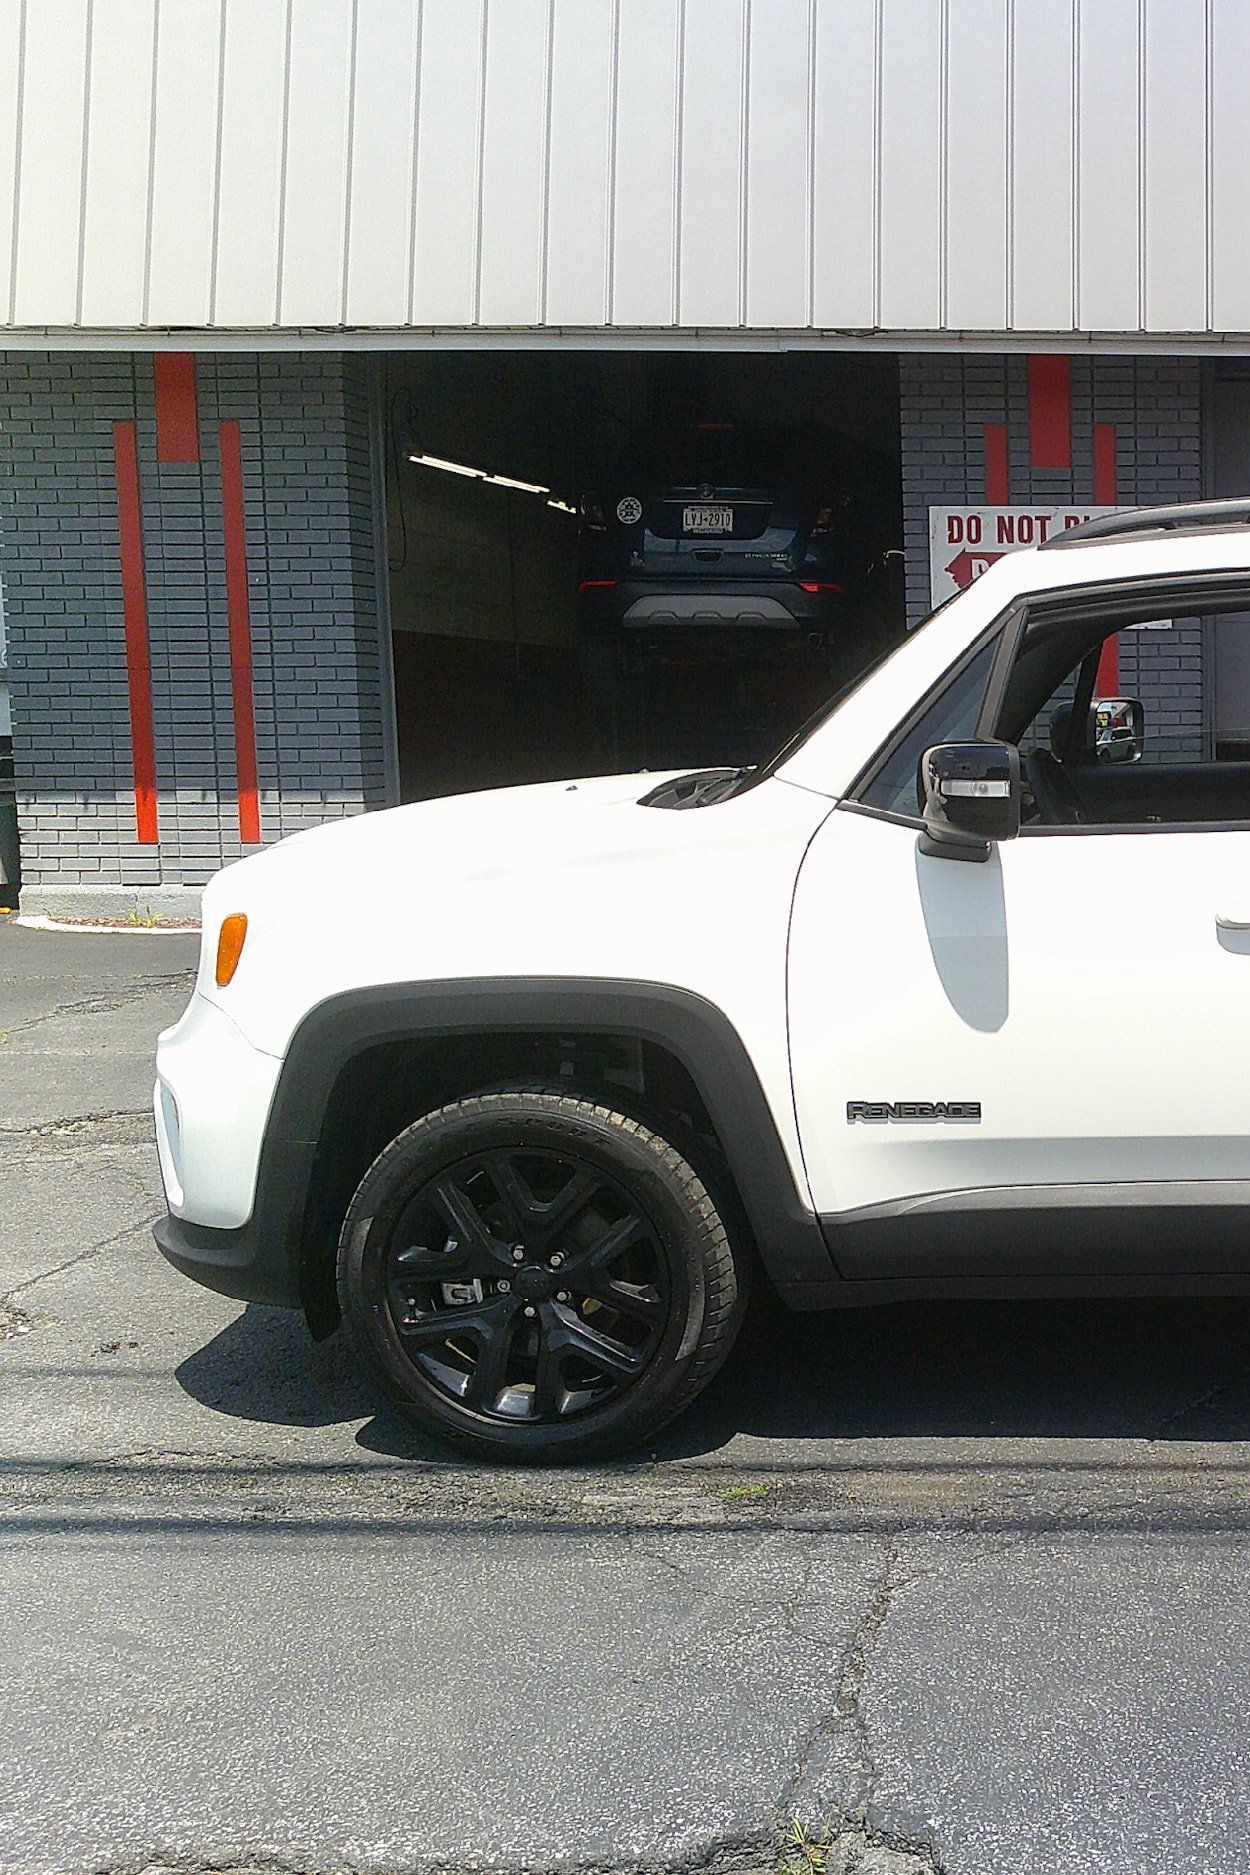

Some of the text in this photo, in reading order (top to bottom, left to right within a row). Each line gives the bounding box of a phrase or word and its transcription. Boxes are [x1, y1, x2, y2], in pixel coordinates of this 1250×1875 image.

[947, 515, 982, 544] DO
[997, 515, 1051, 544] NOT
[847, 1101, 981, 1119] RENEGADE
